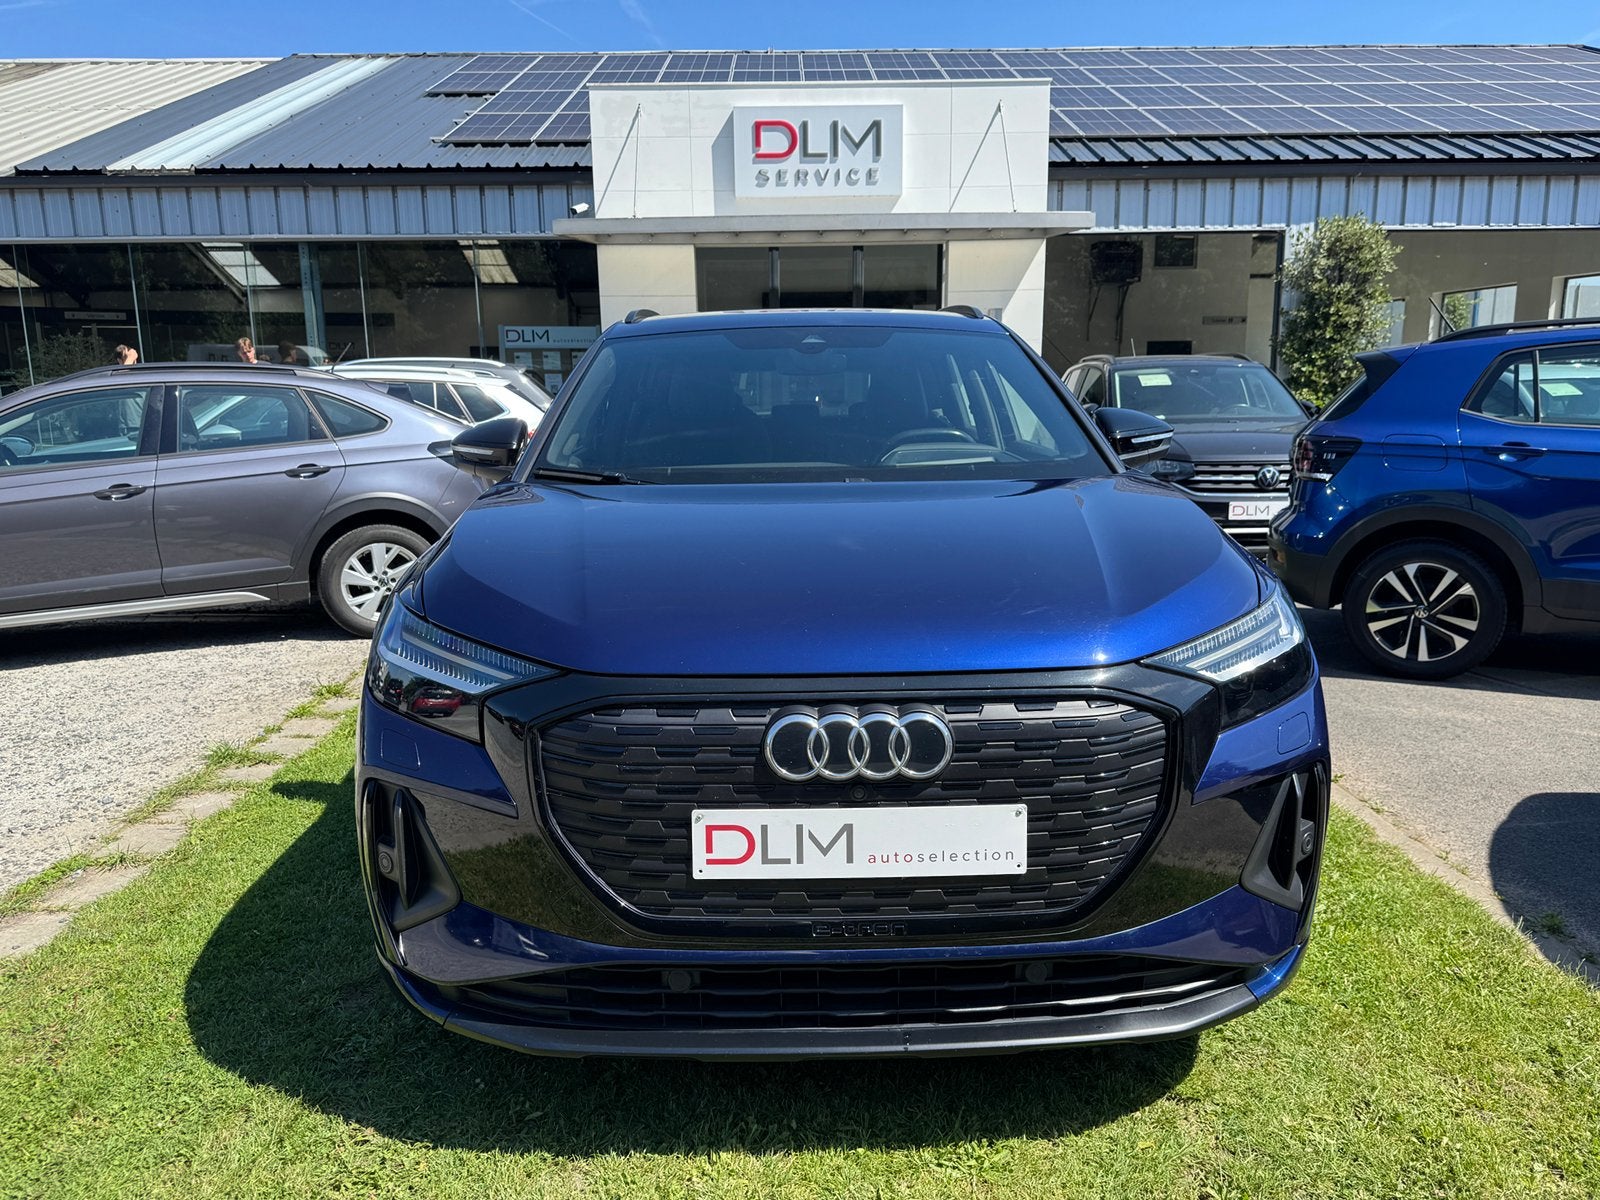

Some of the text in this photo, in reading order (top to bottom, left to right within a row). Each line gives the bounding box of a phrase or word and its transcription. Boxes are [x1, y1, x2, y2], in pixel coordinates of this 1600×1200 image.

[754, 120, 882, 158] DLM
[755, 168, 880, 185] SERVICE
[505, 329, 550, 343] DLM
[1232, 505, 1270, 517] DLM
[705, 823, 1014, 865] DLM autoselection
